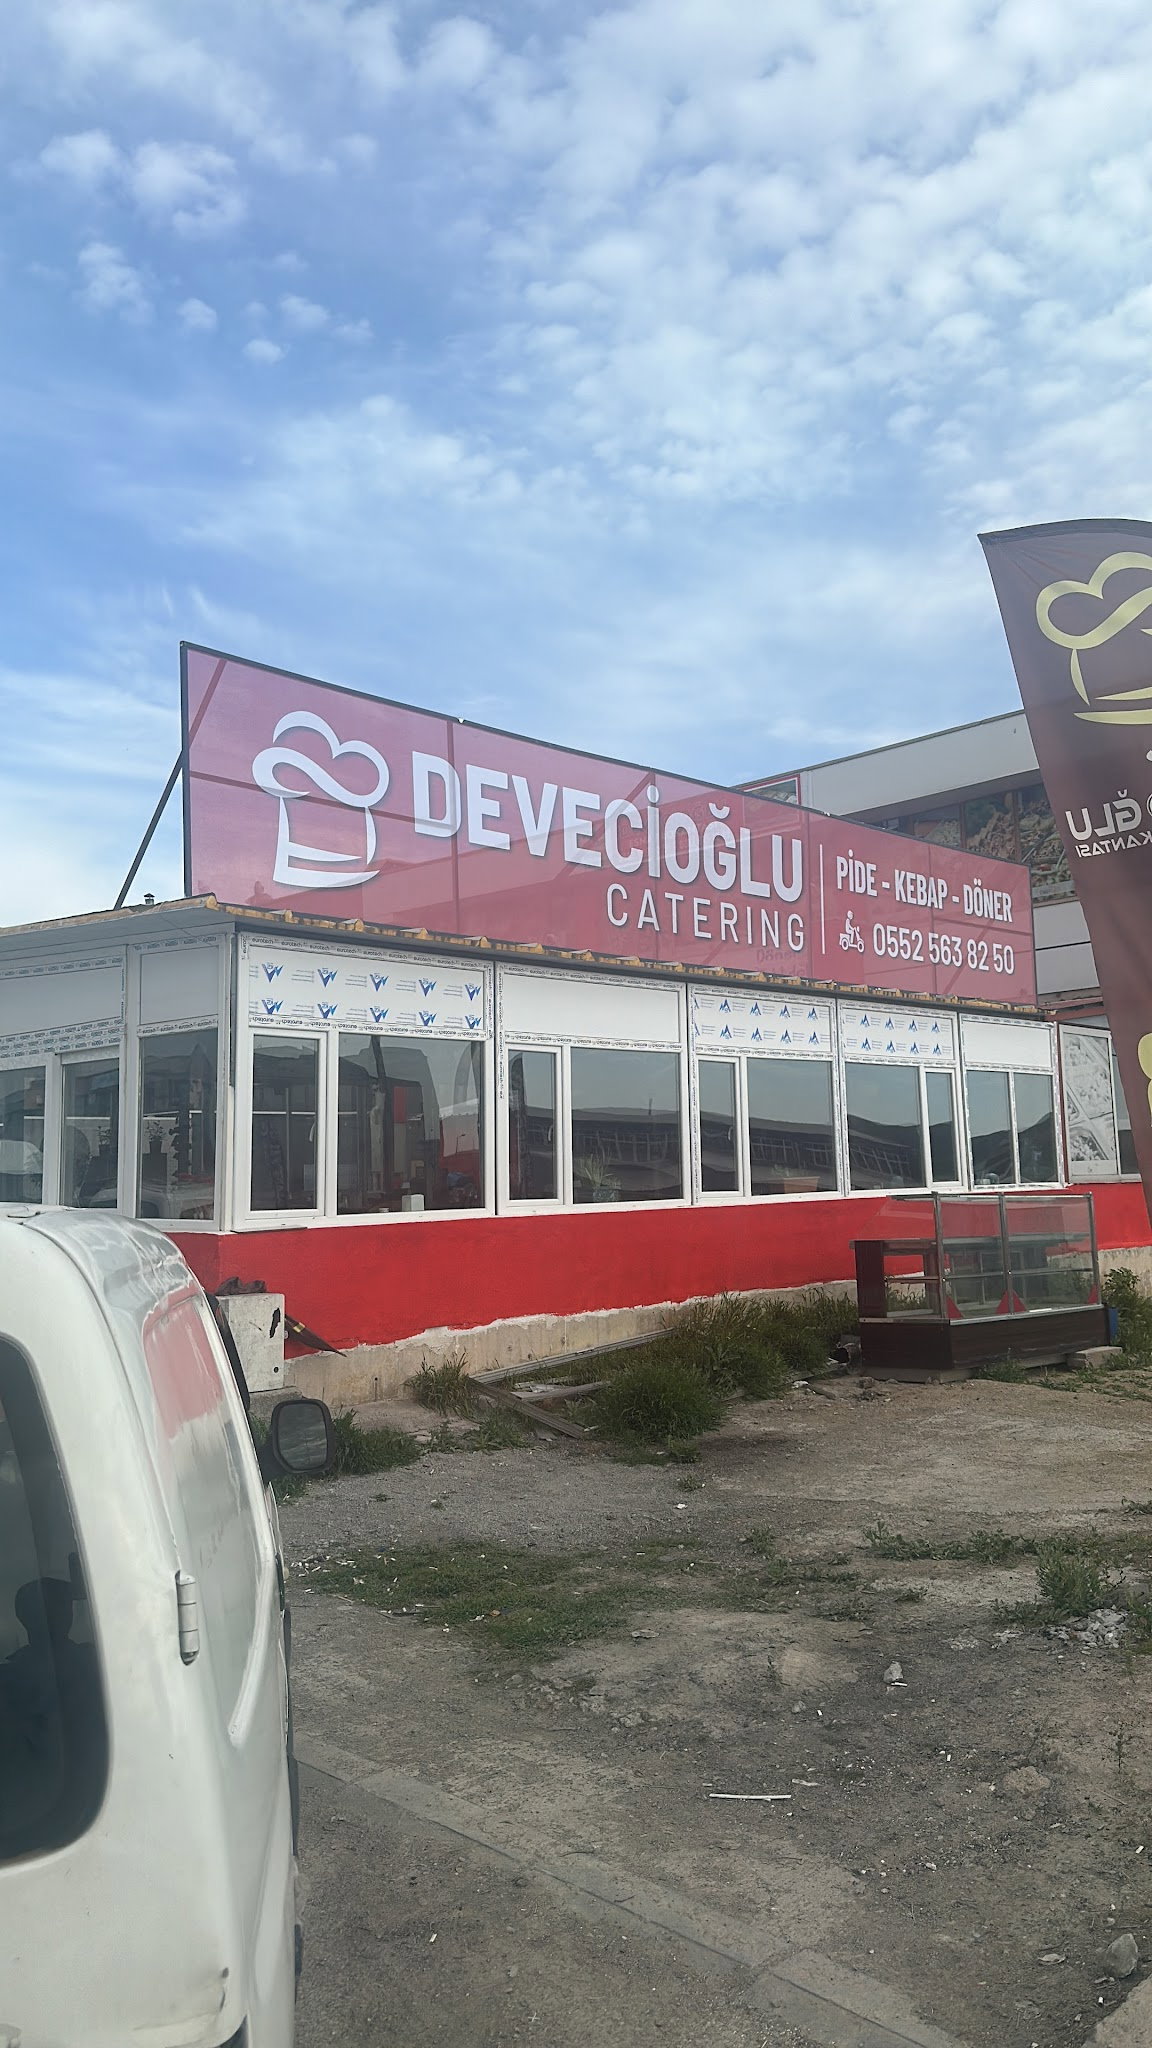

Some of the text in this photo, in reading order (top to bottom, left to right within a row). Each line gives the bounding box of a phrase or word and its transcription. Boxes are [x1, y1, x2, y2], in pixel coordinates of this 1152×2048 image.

[412, 751, 803, 902] DEVECİOĞLU
[606, 883, 804, 952] CATERING
[836, 849, 878, 897] PİDE
[882, 881, 890, 889] -
[895, 869, 948, 909] KEBAP
[963, 878, 1013, 922] DÖNER
[873, 923, 1015, 975] 0552 563 82 50
